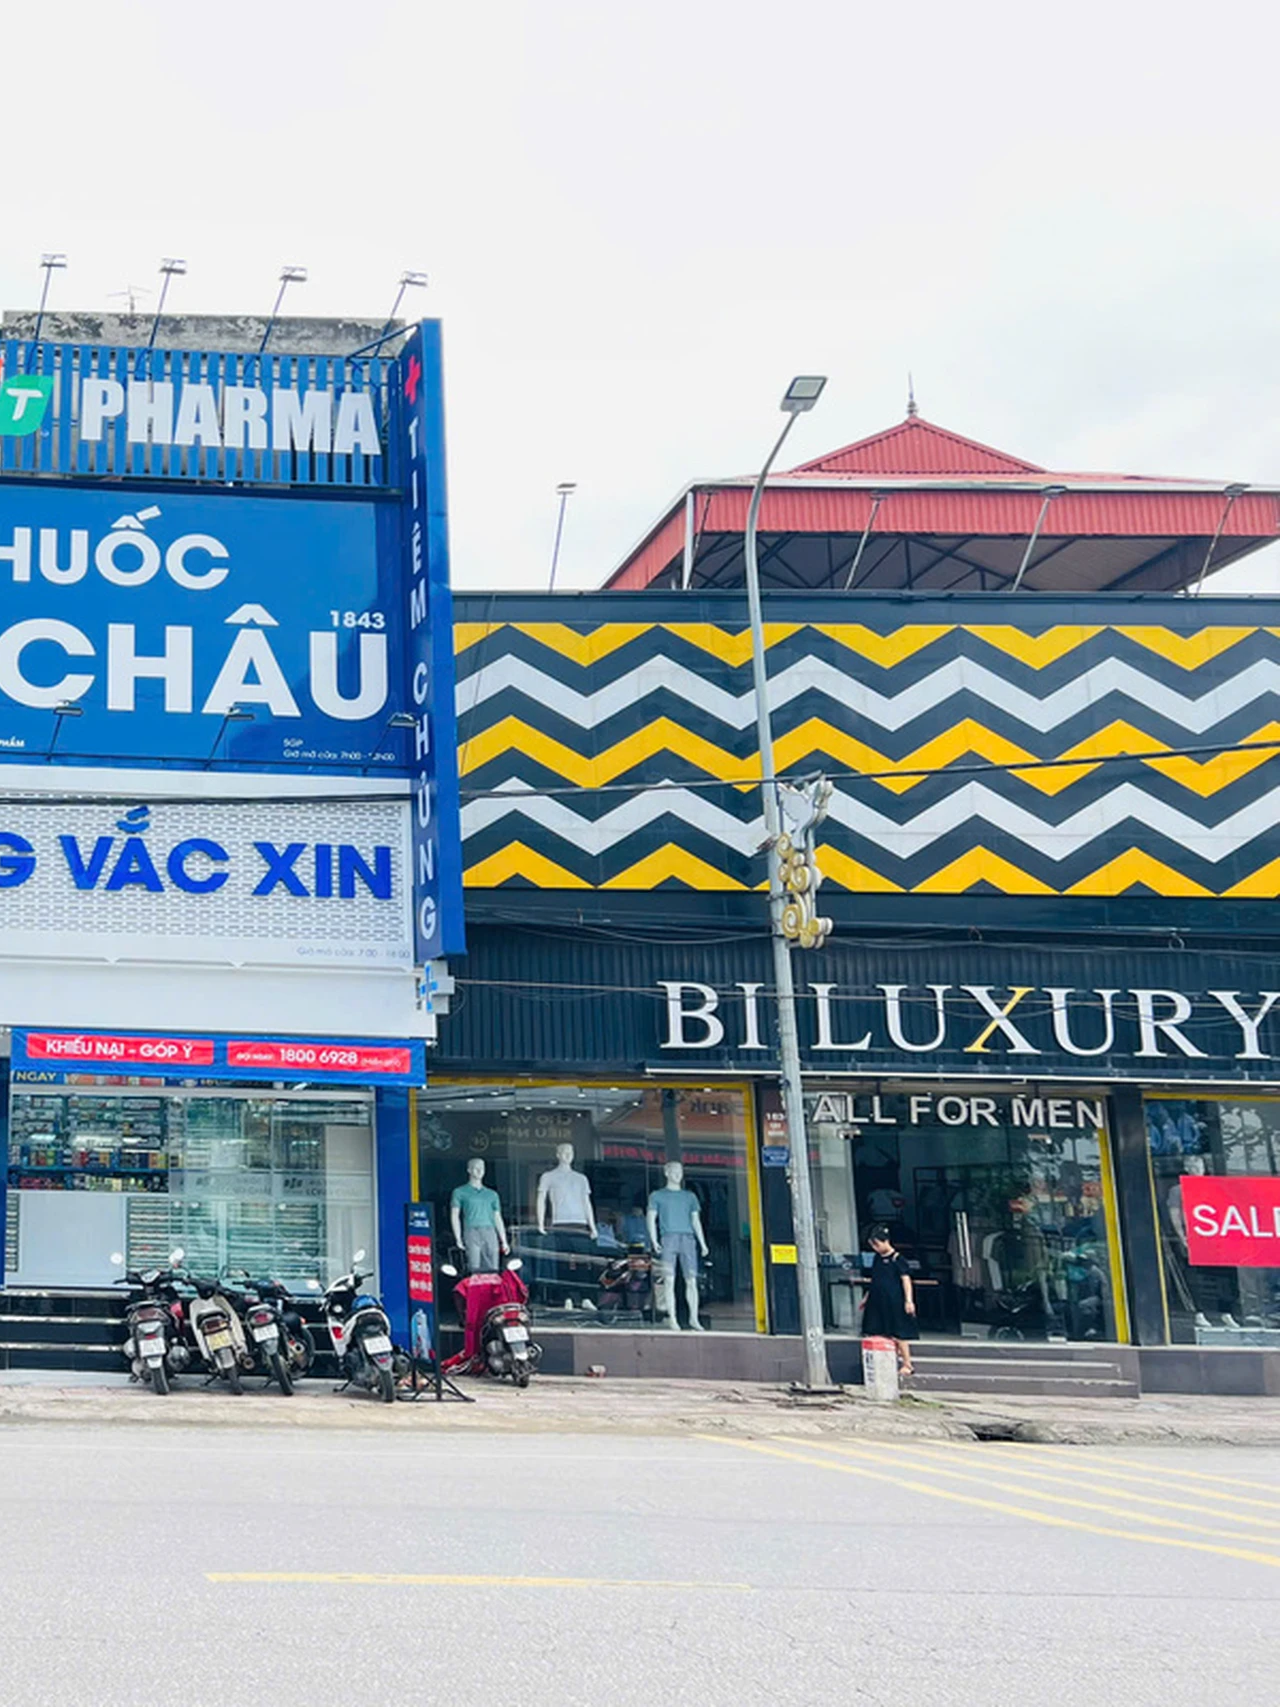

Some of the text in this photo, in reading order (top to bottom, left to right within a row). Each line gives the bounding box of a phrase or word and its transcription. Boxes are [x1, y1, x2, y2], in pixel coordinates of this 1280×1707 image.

[81, 378, 382, 456] PHARMA
[329, 611, 385, 629] 1843
[58, 805, 230, 894] VẮC
[251, 841, 393, 900] XIN
[45, 1036, 93, 1055] KHIẾU
[95, 1041, 125, 1060] NẠI
[139, 1043, 179, 1058] GÓP
[183, 1043, 194, 1058] Ý
[280, 1048, 316, 1063] 1800
[319, 1049, 359, 1065] 6928
[16, 1071, 57, 1082] NGAY
[813, 1094, 1105, 1130] ALL FOR MEN
